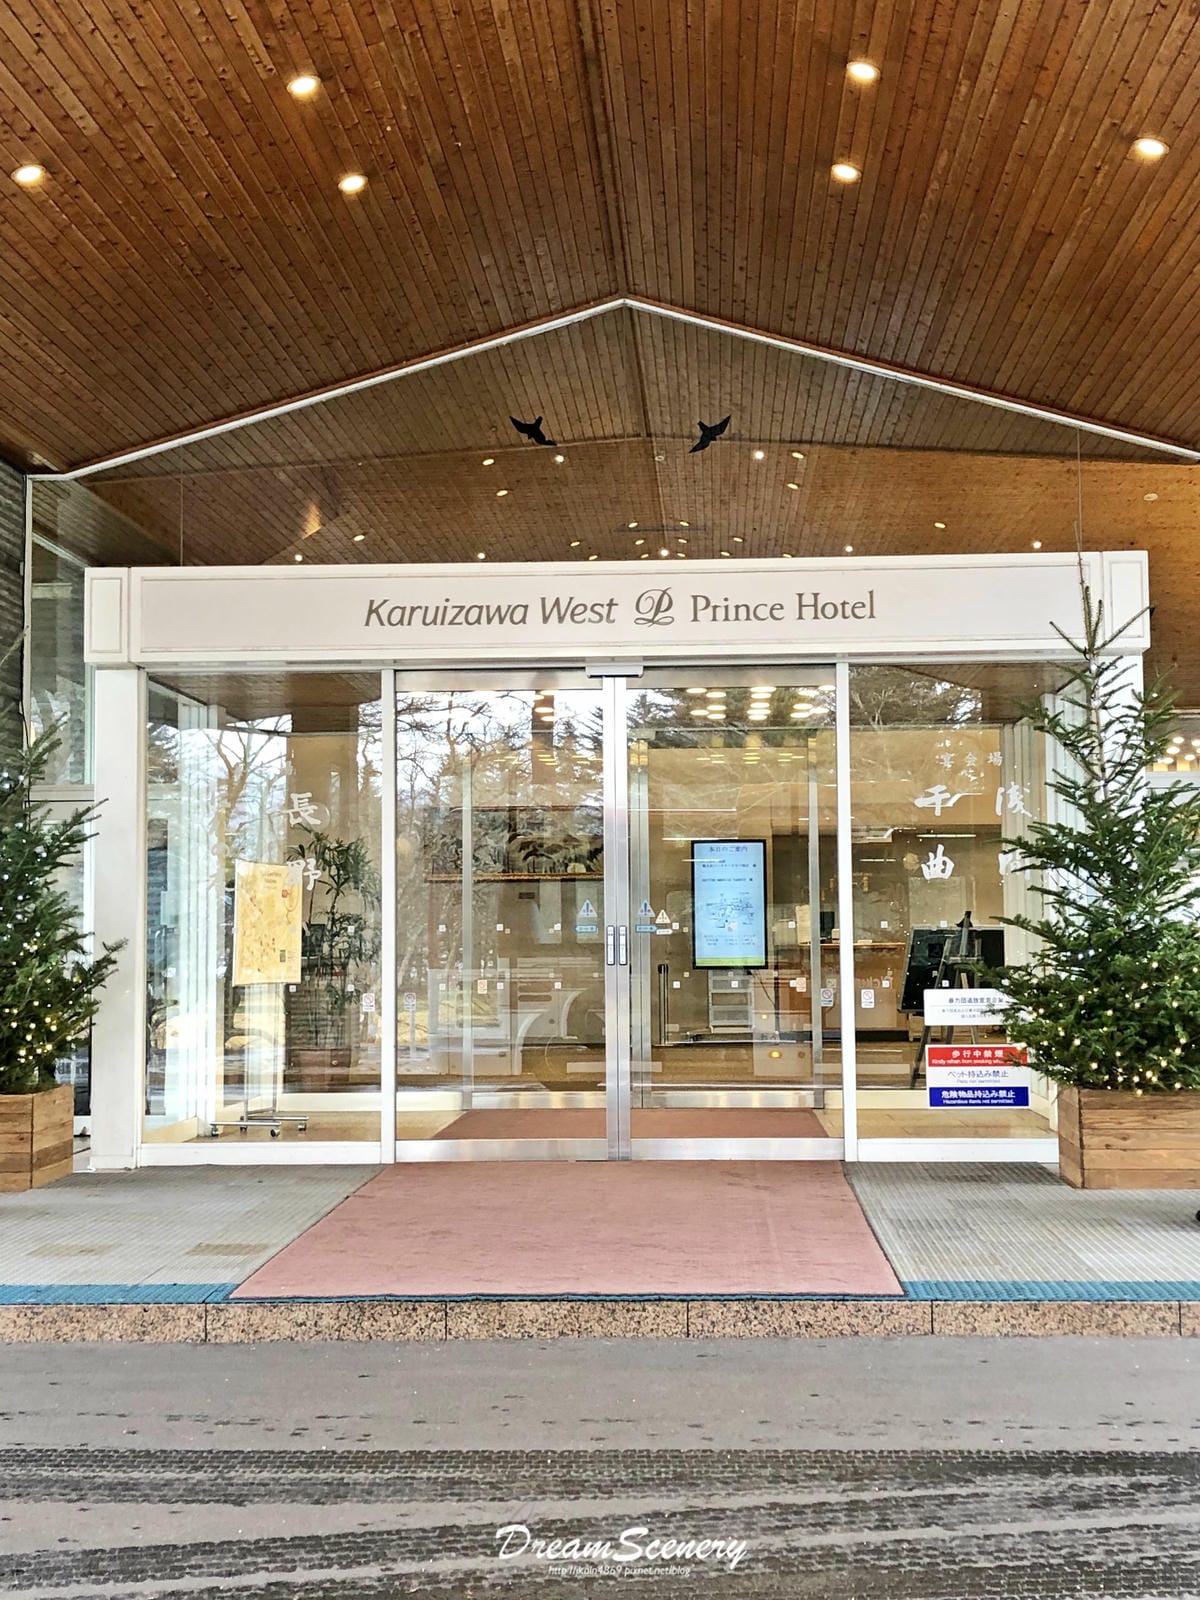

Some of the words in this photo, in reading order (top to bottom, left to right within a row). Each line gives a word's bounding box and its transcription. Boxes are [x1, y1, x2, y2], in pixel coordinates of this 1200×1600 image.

[364, 598, 529, 627] Karuizawa
[538, 596, 619, 626] West
[690, 594, 785, 623] Prince
[796, 590, 876, 620] Hotel
[286, 792, 322, 891] 長野
